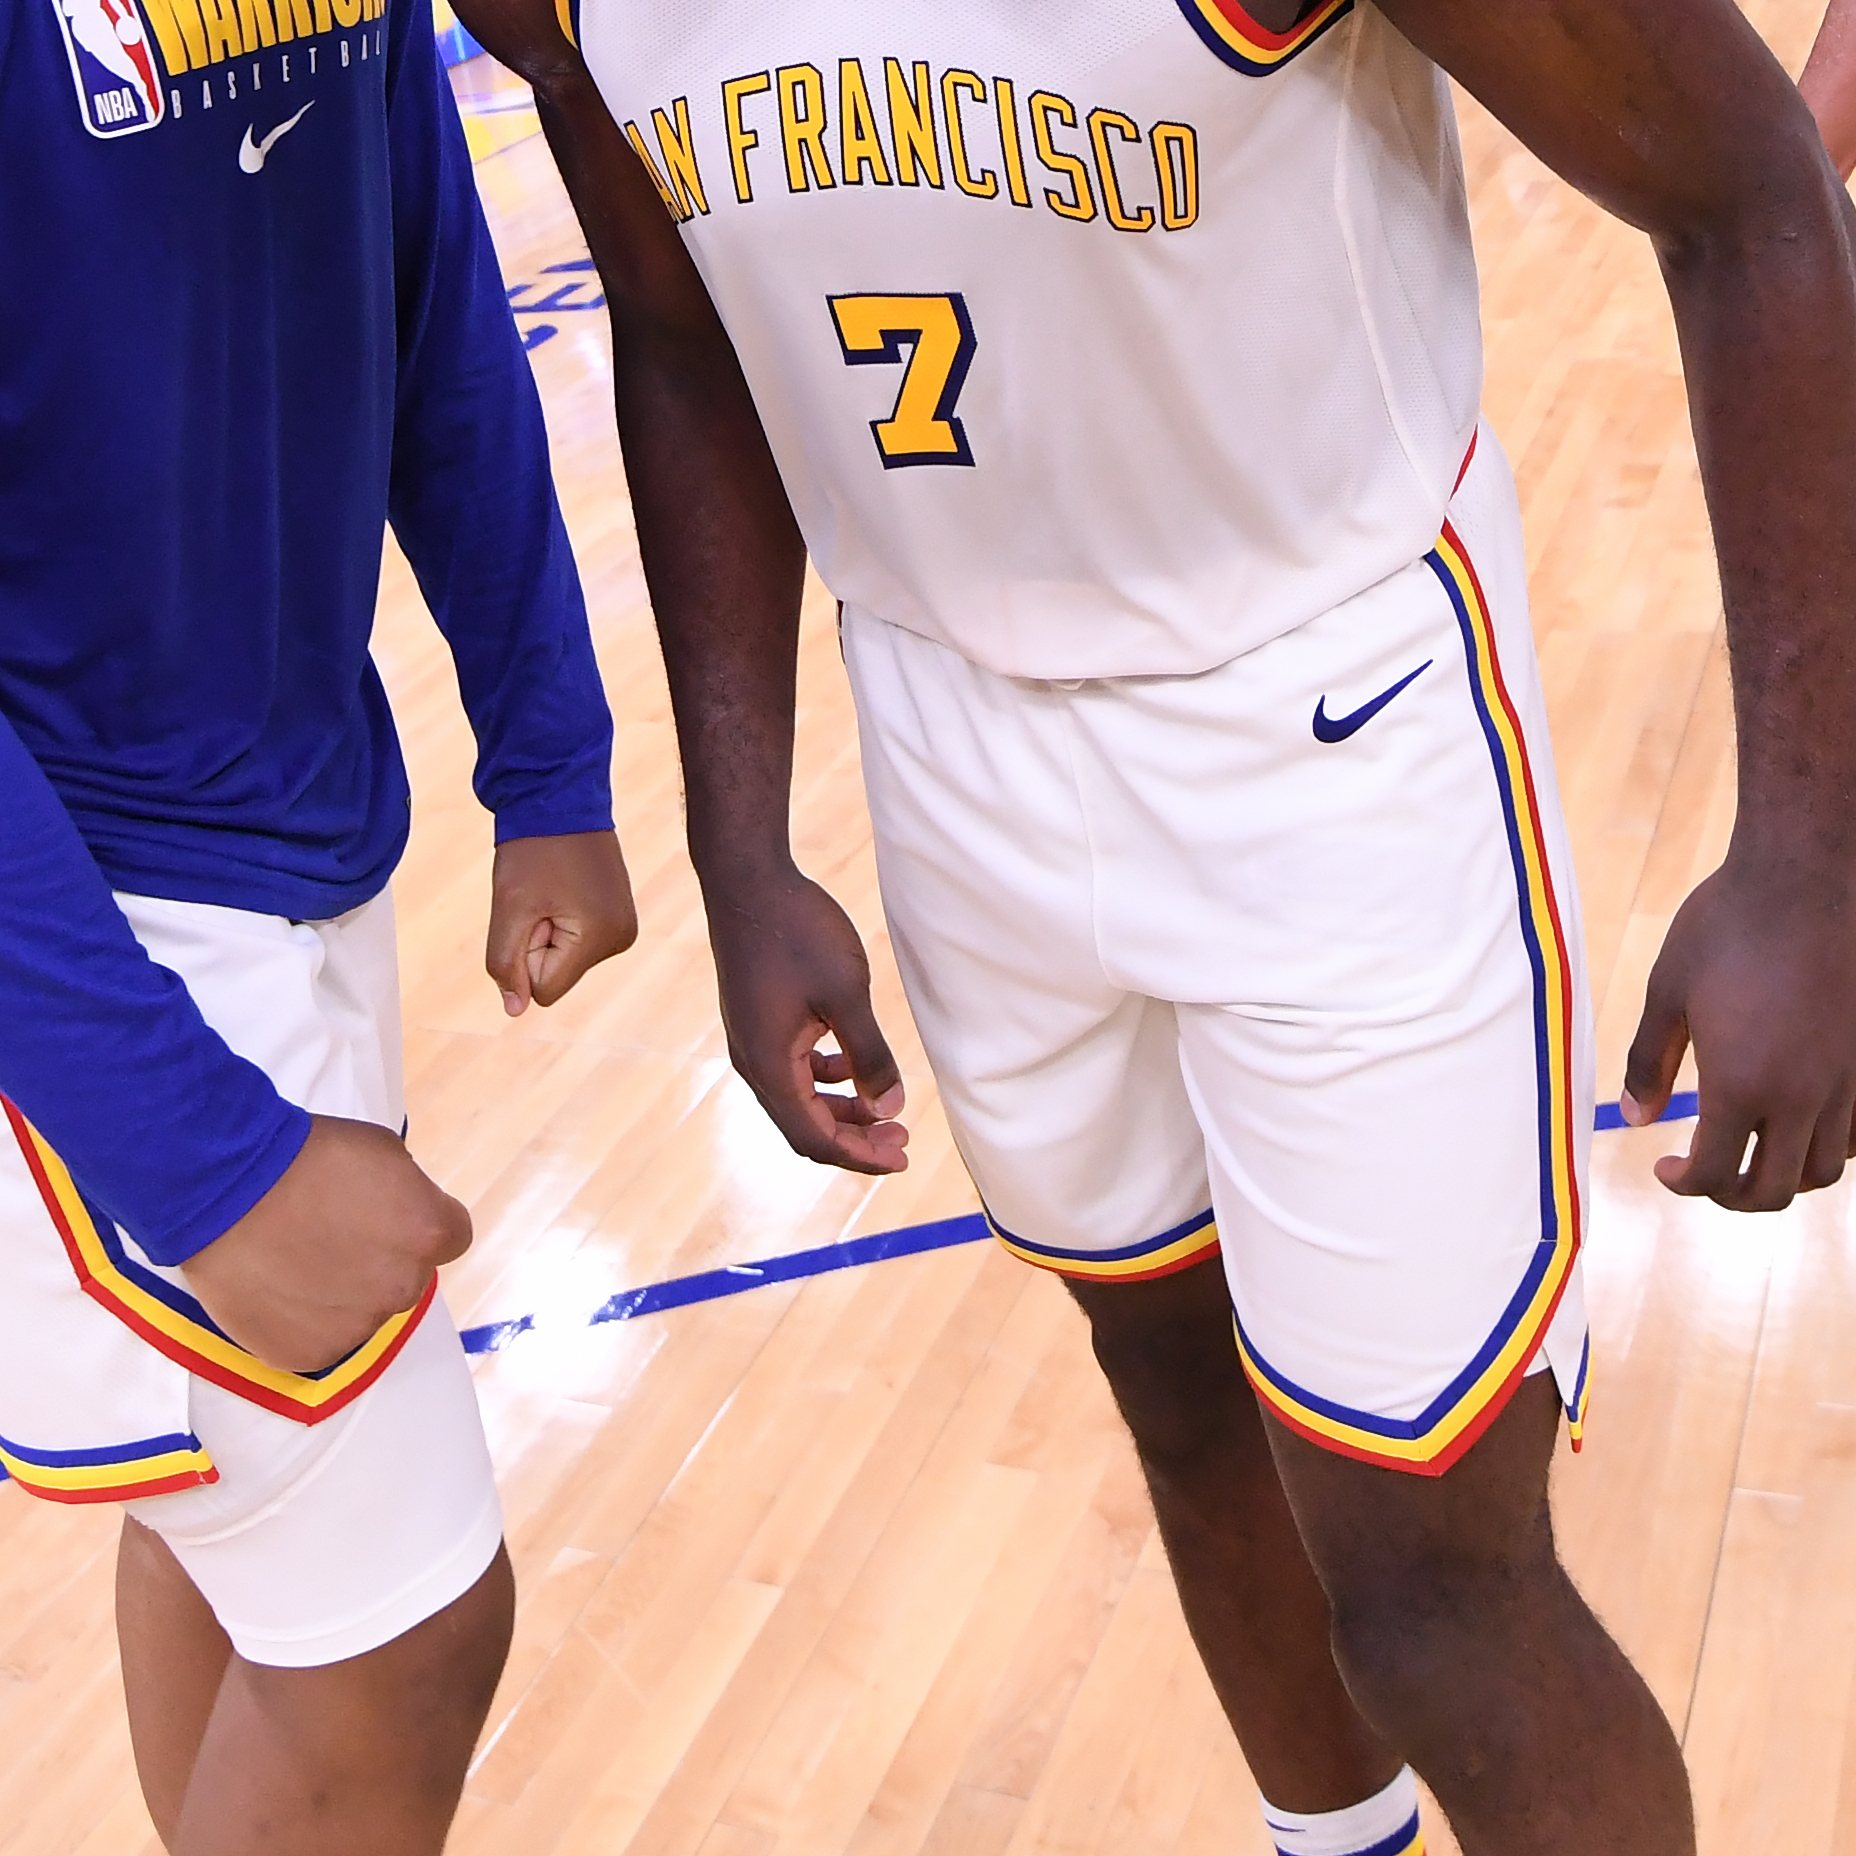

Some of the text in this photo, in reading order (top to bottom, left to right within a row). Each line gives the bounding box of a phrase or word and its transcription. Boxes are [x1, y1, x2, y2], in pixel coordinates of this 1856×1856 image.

[94, 87, 138, 125] NBA
[624, 57, 1198, 232] AN FRANCISCO
[825, 291, 979, 470] 7
